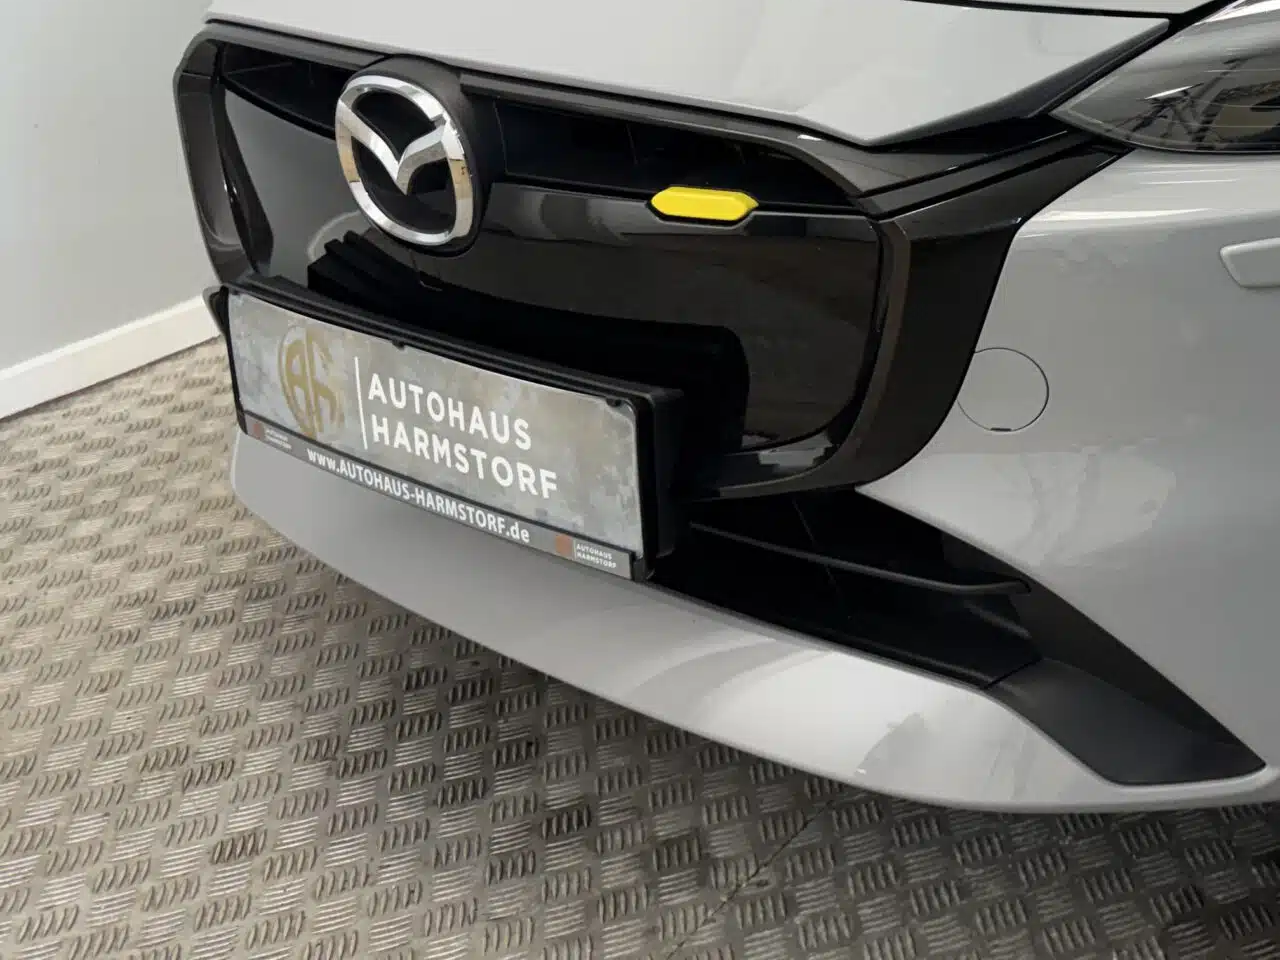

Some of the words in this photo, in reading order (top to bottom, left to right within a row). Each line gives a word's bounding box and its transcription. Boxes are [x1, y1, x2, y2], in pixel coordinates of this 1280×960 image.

[368, 373, 532, 451] AUTOHAUS
[307, 448, 531, 544] www.AUTOHAUS-HARMSTORF.de
[372, 413, 558, 500] HARMSTORF
[576, 543, 613, 561] AUTOHAUS
